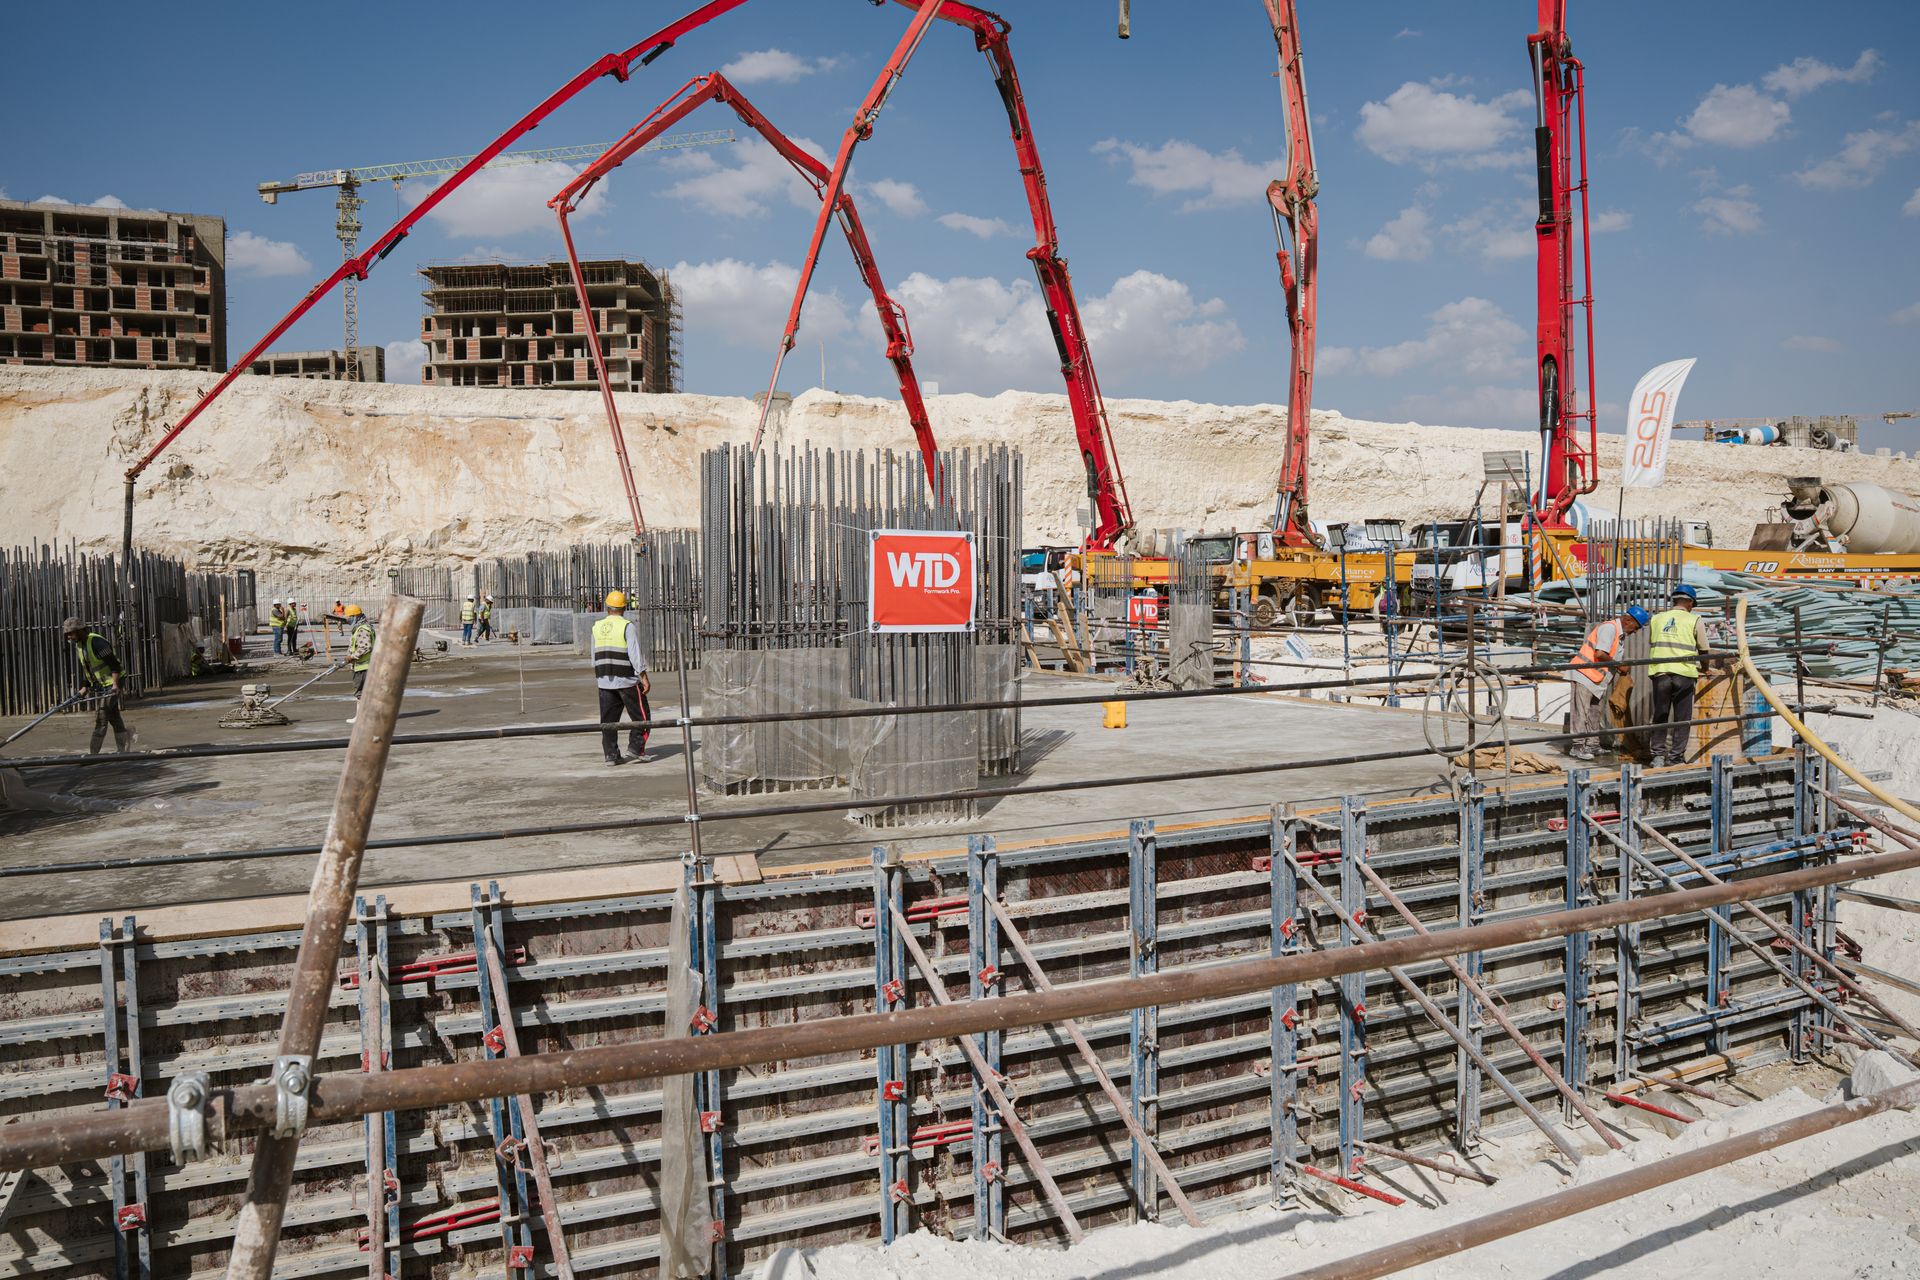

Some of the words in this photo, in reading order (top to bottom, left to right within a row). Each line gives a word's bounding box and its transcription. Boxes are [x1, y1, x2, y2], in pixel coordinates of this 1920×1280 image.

[1743, 561, 1779, 573] C10
[1790, 553, 1845, 568] Reliance
[887, 552, 961, 587] WTD
[1330, 567, 1375, 579] Rliance
[1134, 603, 1158, 617] WTD
